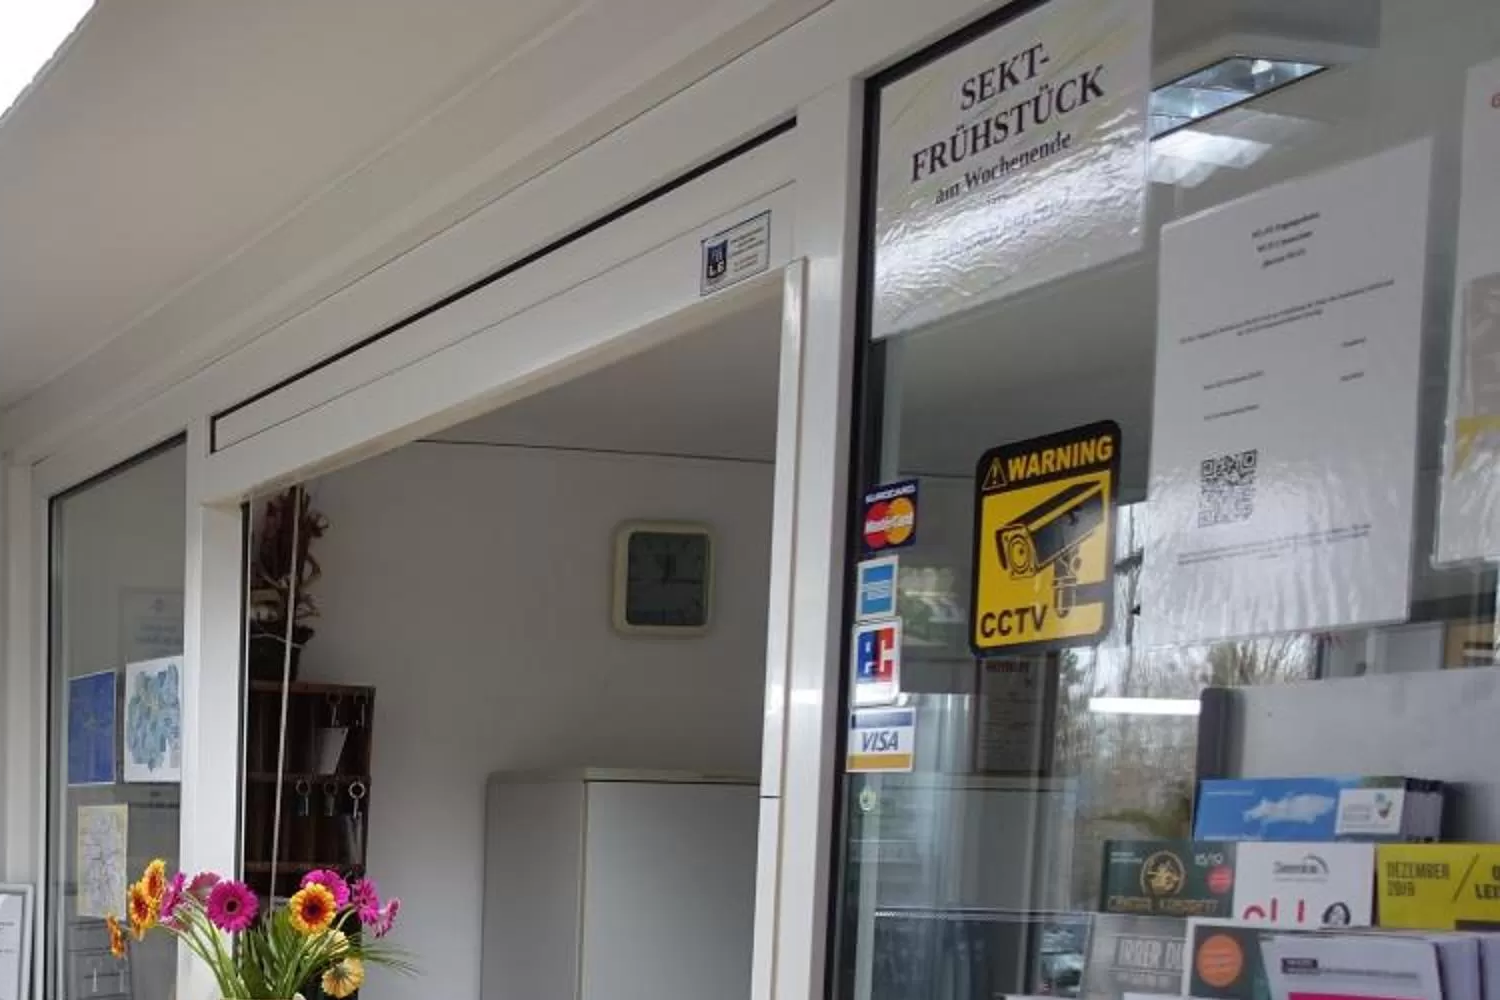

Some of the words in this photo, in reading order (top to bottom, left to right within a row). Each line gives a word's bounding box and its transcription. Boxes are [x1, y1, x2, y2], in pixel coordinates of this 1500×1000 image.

[960, 43, 1050, 110] SEKT-
[912, 64, 1105, 183] FRÜHSTÜCK
[965, 131, 1072, 191] Wochenende
[1007, 435, 1114, 482] WARNING
[980, 604, 1048, 639] CCTV
[862, 731, 900, 752] VISA
